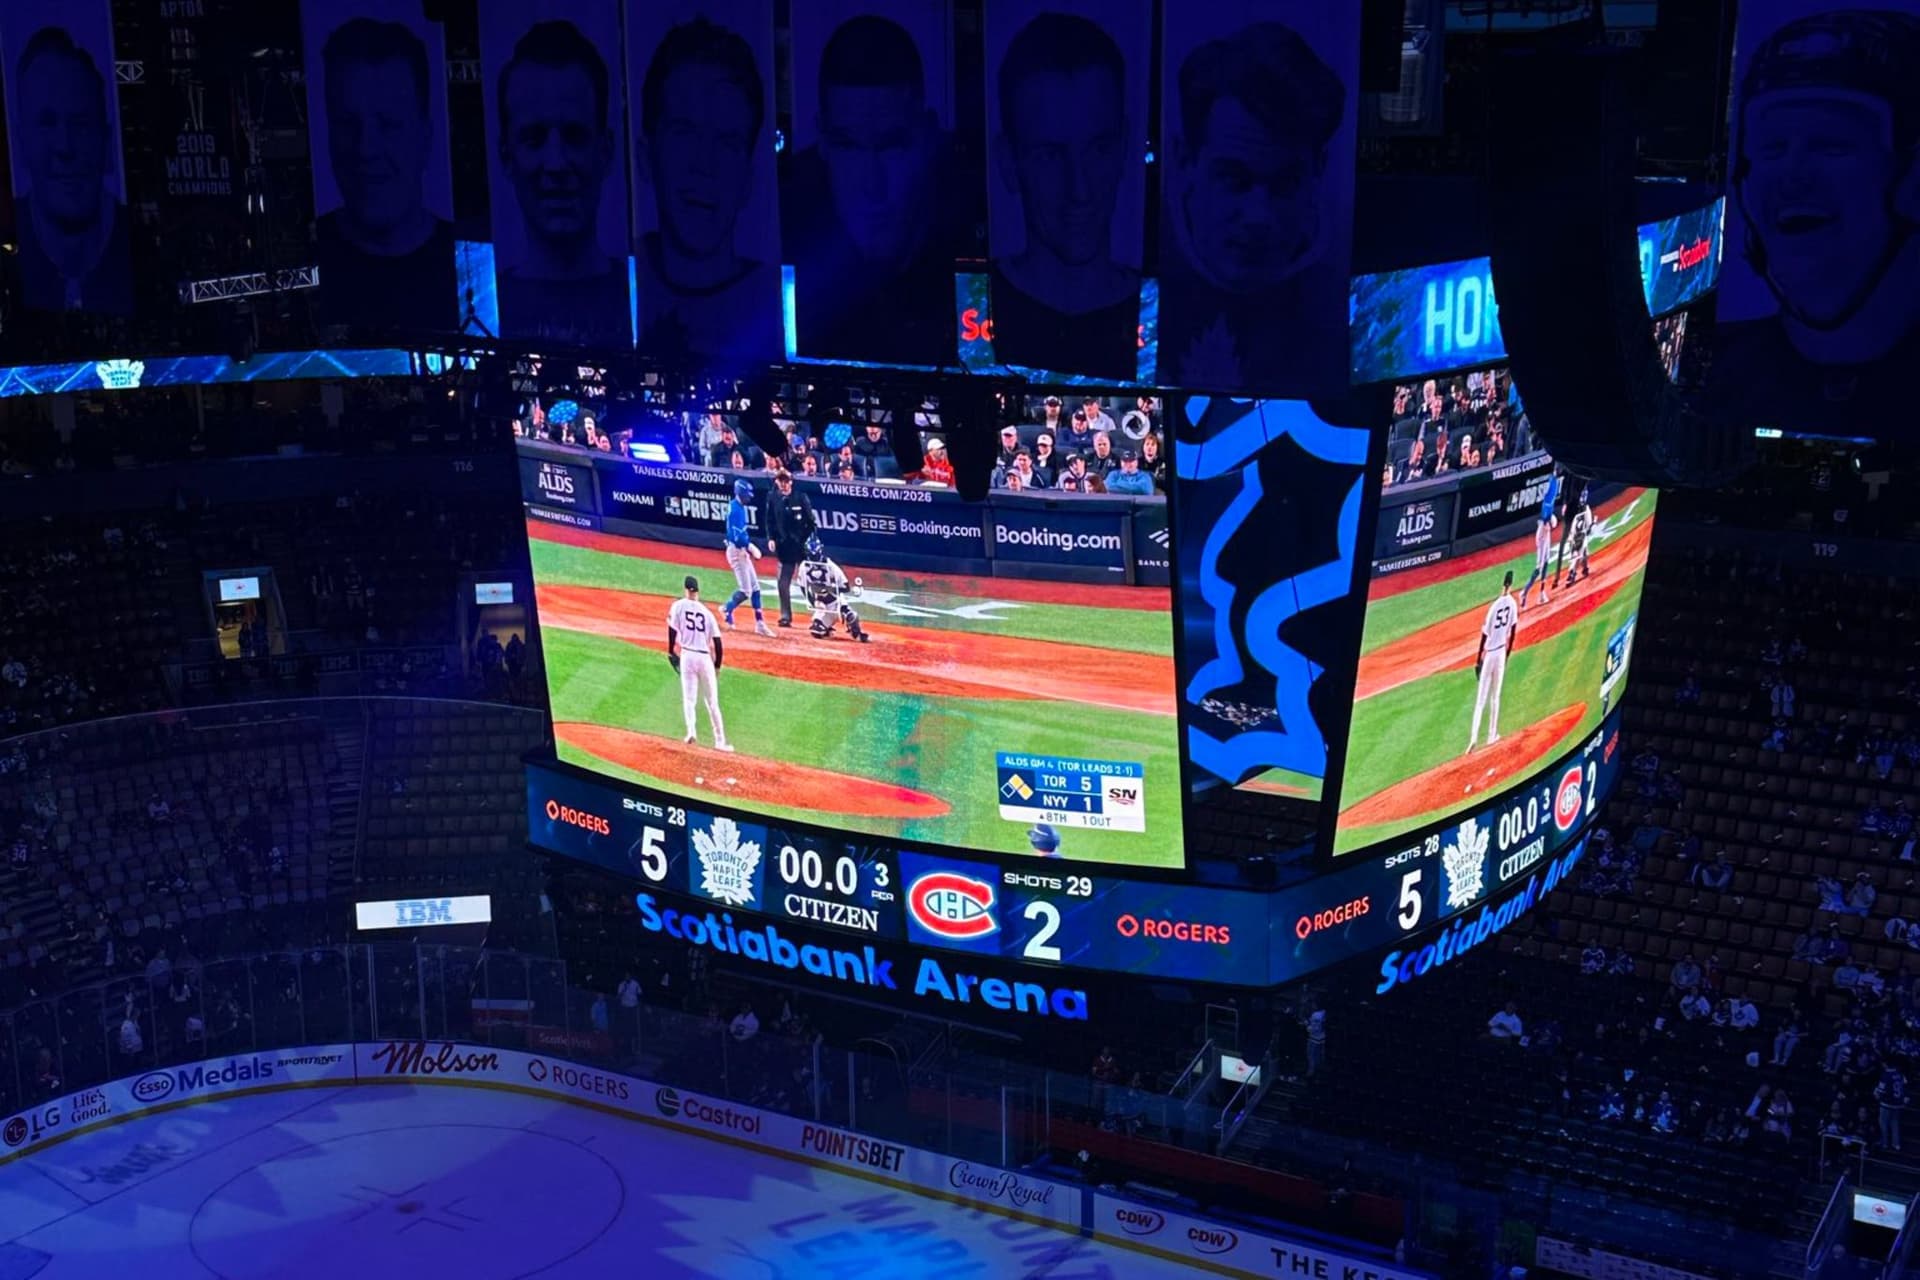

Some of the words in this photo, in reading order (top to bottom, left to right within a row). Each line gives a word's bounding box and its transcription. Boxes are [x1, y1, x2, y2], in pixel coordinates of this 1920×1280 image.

[177, 133, 216, 154] 2019
[165, 154, 231, 180] WORLD
[168, 182, 232, 196] CHAMPIONS
[451, 460, 475, 473] 116
[632, 464, 726, 485] YANKEES.COM/2026
[538, 472, 575, 494] ALDS
[820, 483, 932, 503] YANKEES.COM/2026
[612, 490, 655, 507] KONAMI
[681, 498, 710, 519] PRO
[1468, 500, 1501, 518] KONAMI
[813, 509, 859, 532] ALDS
[860, 517, 897, 532] 2025
[900, 518, 982, 539] Booking.com
[1396, 511, 1435, 537] ALDS
[995, 525, 1121, 551] Booking.com
[1812, 543, 1839, 558] 119
[1138, 559, 1161, 568] BANK
[684, 611, 706, 632] 53
[1494, 606, 1510, 629] 53
[1004, 756, 1029, 768] ALDS
[1030, 759, 1046, 769] GM
[1058, 760, 1080, 773] (TOR
[1082, 763, 1114, 775] LEADS
[1042, 775, 1067, 788] TOR
[1081, 777, 1092, 792] 5
[1109, 788, 1137, 800] SN
[1585, 761, 1597, 817] 2
[1043, 795, 1069, 808] NYY
[1083, 797, 1092, 812] 1
[1543, 787, 1551, 811] 3
[561, 806, 610, 836] ROGERS
[623, 798, 663, 817] SHOTS
[667, 806, 686, 827] 28
[1046, 813, 1067, 824] 8TH
[1089, 817, 1112, 827] OUT
[1499, 797, 1538, 851] 00.0
[640, 825, 668, 882] 5
[705, 851, 748, 872] TORONTO
[1385, 846, 1421, 870] SHOTS
[1425, 834, 1440, 857] 28
[1500, 836, 1546, 882] CITIZEN
[713, 864, 742, 878] MAPLE
[713, 874, 742, 889] LEAFS
[779, 845, 858, 895] 00.0
[874, 862, 890, 887] 3
[1004, 872, 1062, 890] SHOTS
[1066, 876, 1093, 897] 29
[1398, 869, 1422, 930] 5
[395, 900, 453, 925] IBM
[784, 893, 879, 932] CITIZEN
[1314, 896, 1370, 932] ROGERS
[1022, 901, 1062, 961] 2
[1143, 919, 1231, 945] ROGERS
[1376, 875, 1539, 994] Scotiabank
[636, 893, 897, 990] Scotiabank
[914, 959, 1089, 1021] Arena
[372, 1041, 498, 1074] Molson
[178, 1057, 273, 1091] Medals
[553, 1066, 628, 1099] ROGERS
[72, 1089, 106, 1109] Life's
[33, 1108, 60, 1133] LG
[71, 1104, 111, 1124] Good.
[683, 1100, 760, 1133] Castrol
[802, 1125, 904, 1172] POINTSBET
[949, 1160, 999, 1192] Crown
[992, 1172, 1054, 1207] Royal
[1116, 1209, 1153, 1227] CDW
[1188, 1227, 1225, 1247] CDW
[1271, 1248, 1329, 1279] THE
